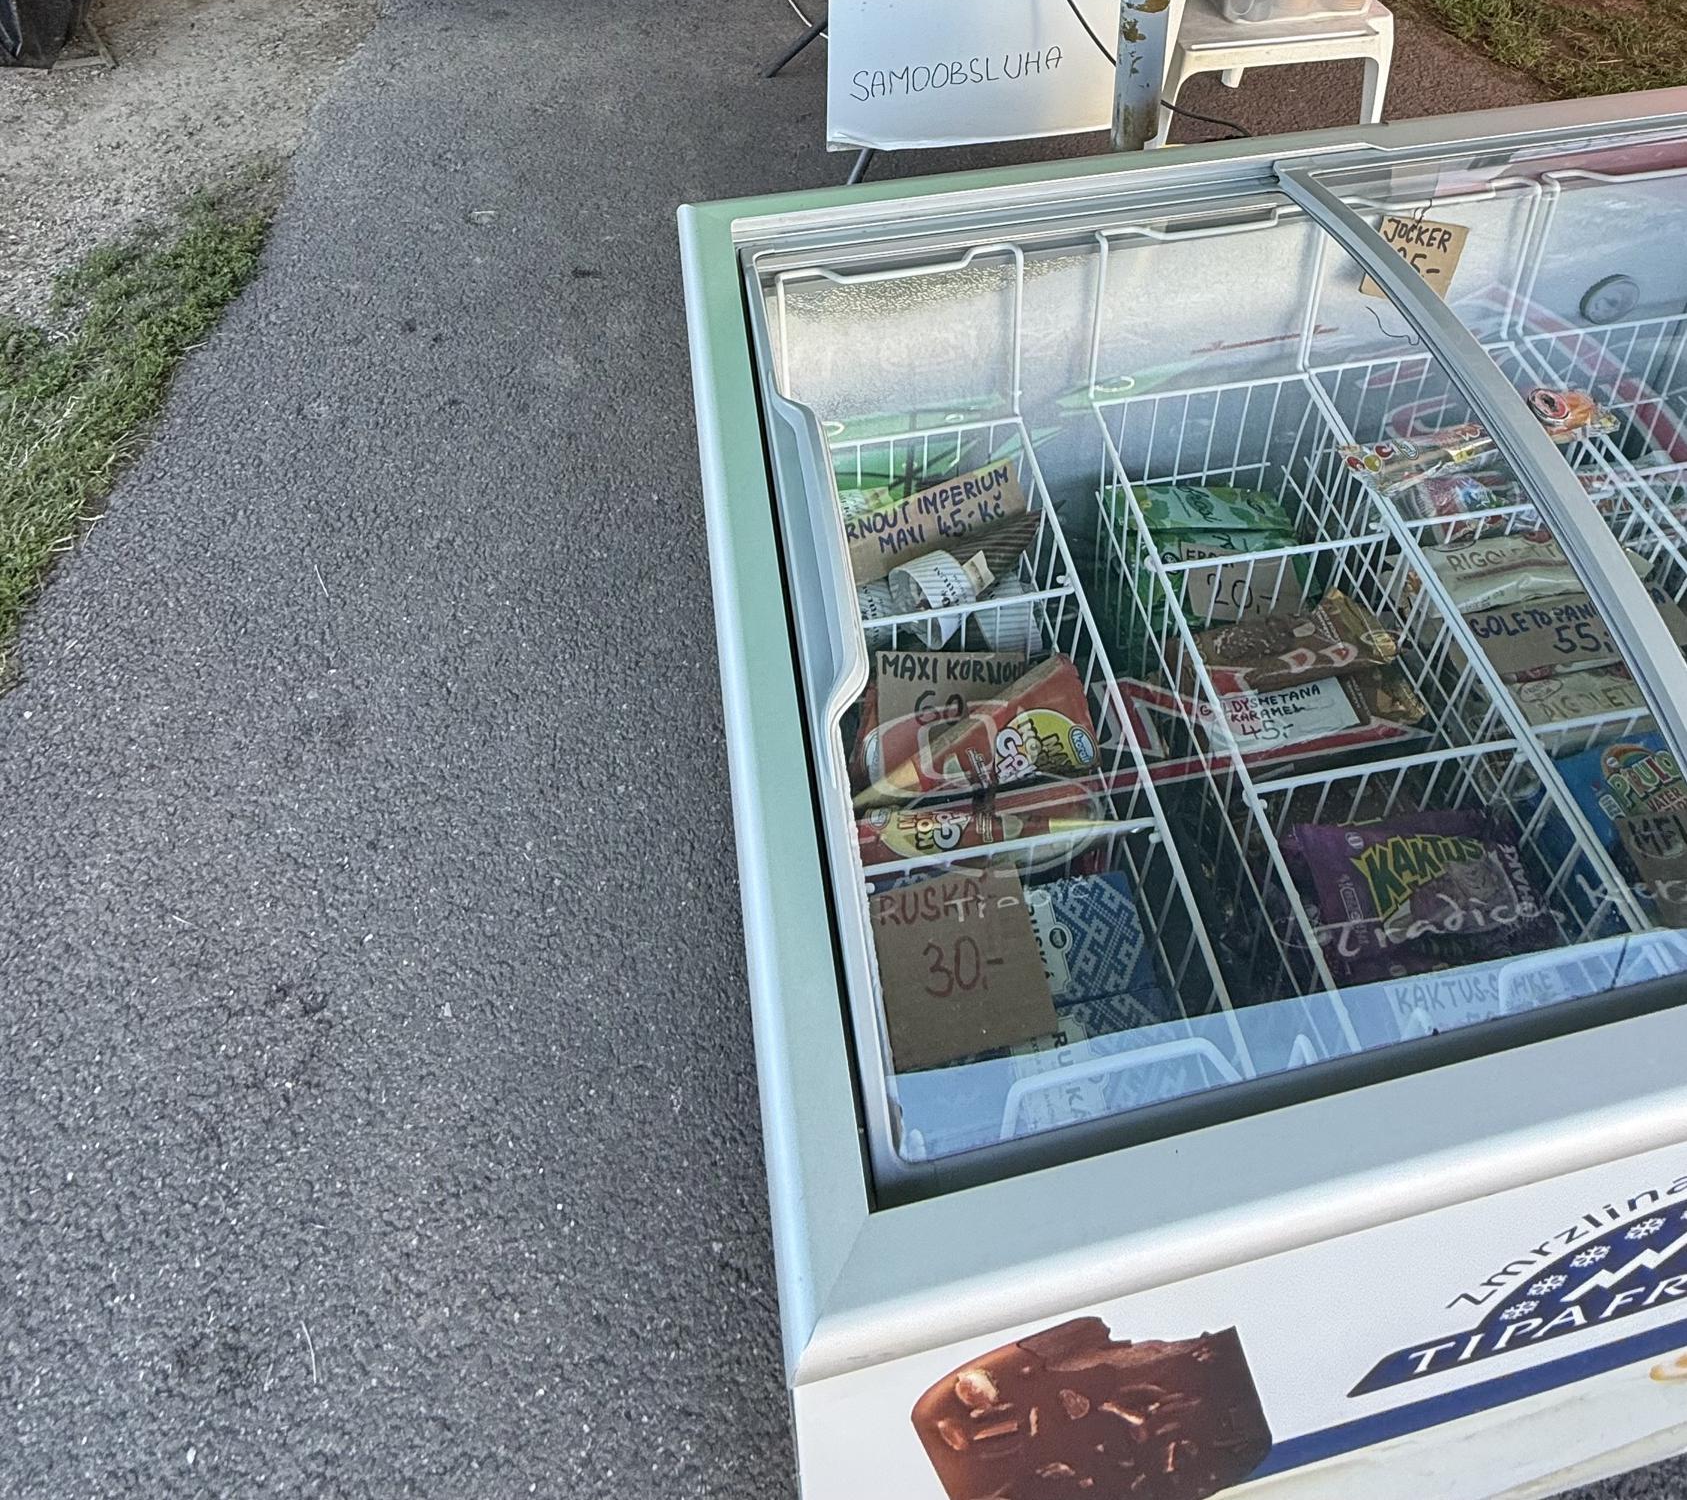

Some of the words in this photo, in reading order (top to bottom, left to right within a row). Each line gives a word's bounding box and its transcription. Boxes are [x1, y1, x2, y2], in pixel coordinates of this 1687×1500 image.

[849, 43, 1064, 102] SAMOOBSLUHA
[1383, 217, 1451, 253] JOCKER
[917, 467, 1009, 515] IMPERIUM
[878, 524, 926, 554] MAXI
[978, 490, 1006, 523] Kč
[882, 653, 938, 683] MAXI
[1200, 698, 1250, 717] GLDY
[1250, 683, 1321, 707] SMETANA
[1231, 705, 1306, 724] KARAMEL
[879, 868, 989, 926] RUSKÁ
[1360, 834, 1486, 918] KAKTUS
